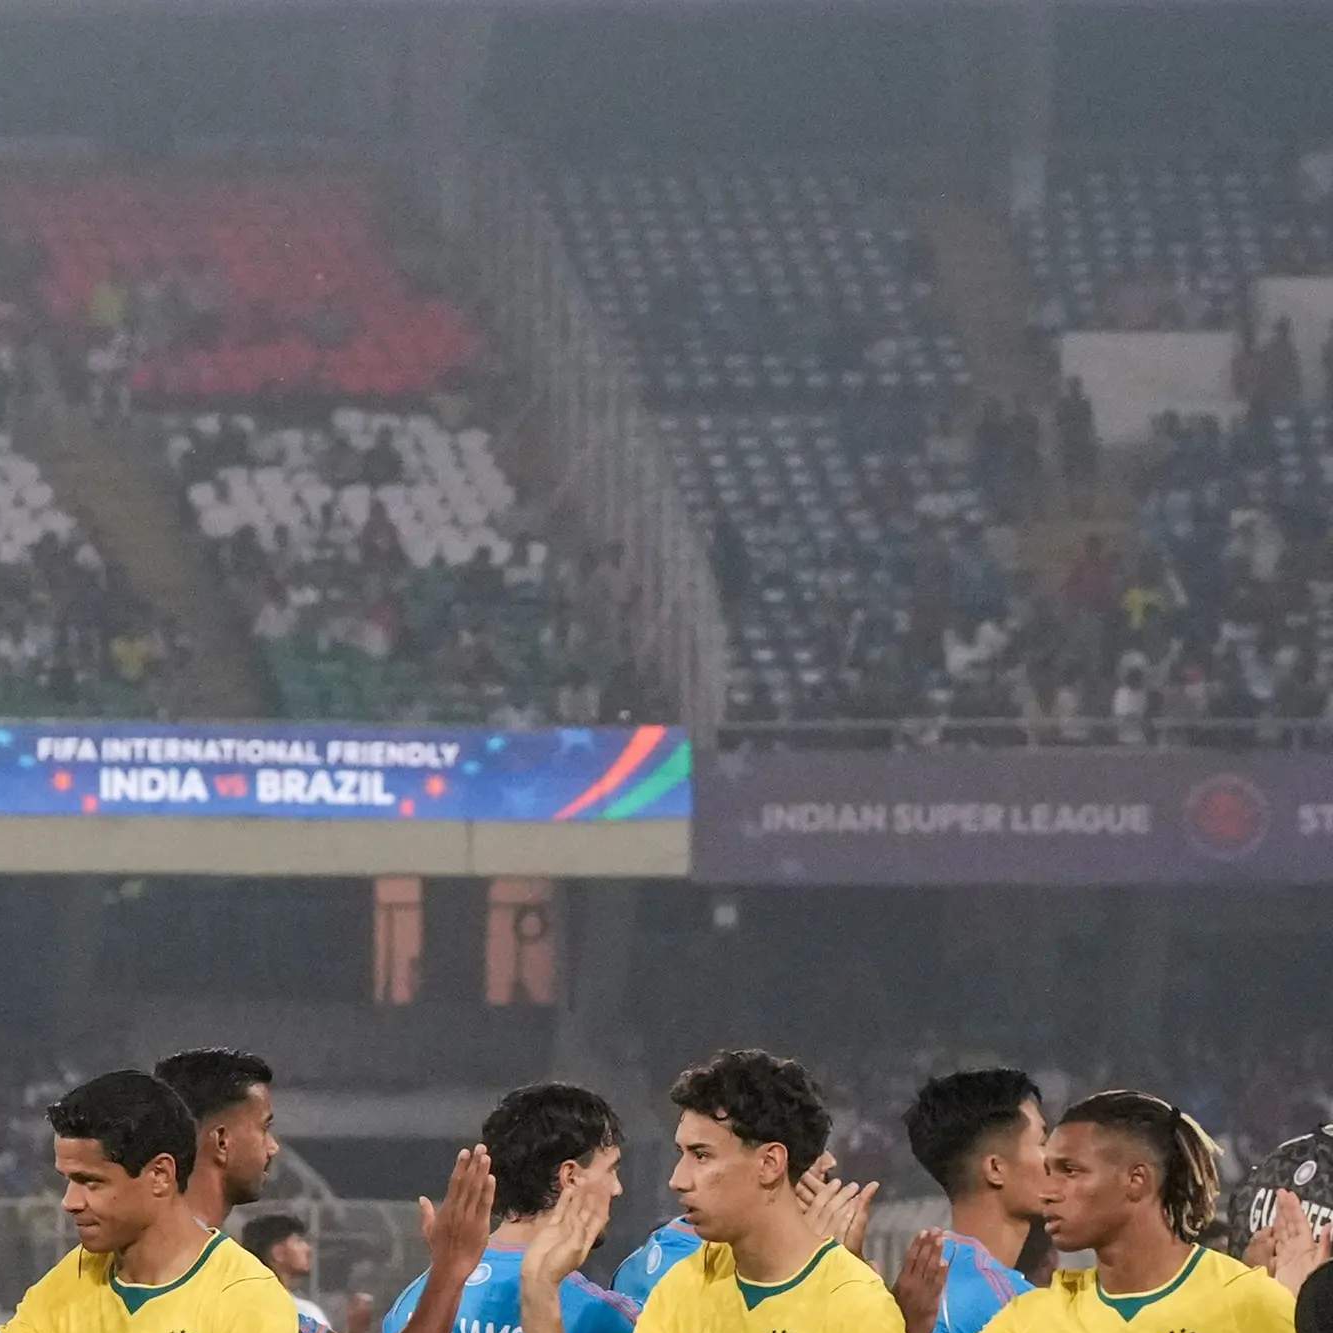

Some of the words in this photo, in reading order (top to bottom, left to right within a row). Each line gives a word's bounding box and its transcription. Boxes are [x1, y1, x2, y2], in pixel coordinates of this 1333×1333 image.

[38, 738, 99, 762] FIFA
[102, 738, 322, 766] INTERNATIONAL
[327, 741, 460, 769] FRIENDLY
[100, 769, 209, 803] INDIA
[257, 770, 397, 807] BRAZIL
[761, 804, 887, 833] INDIAN
[893, 804, 1006, 833] SUPER
